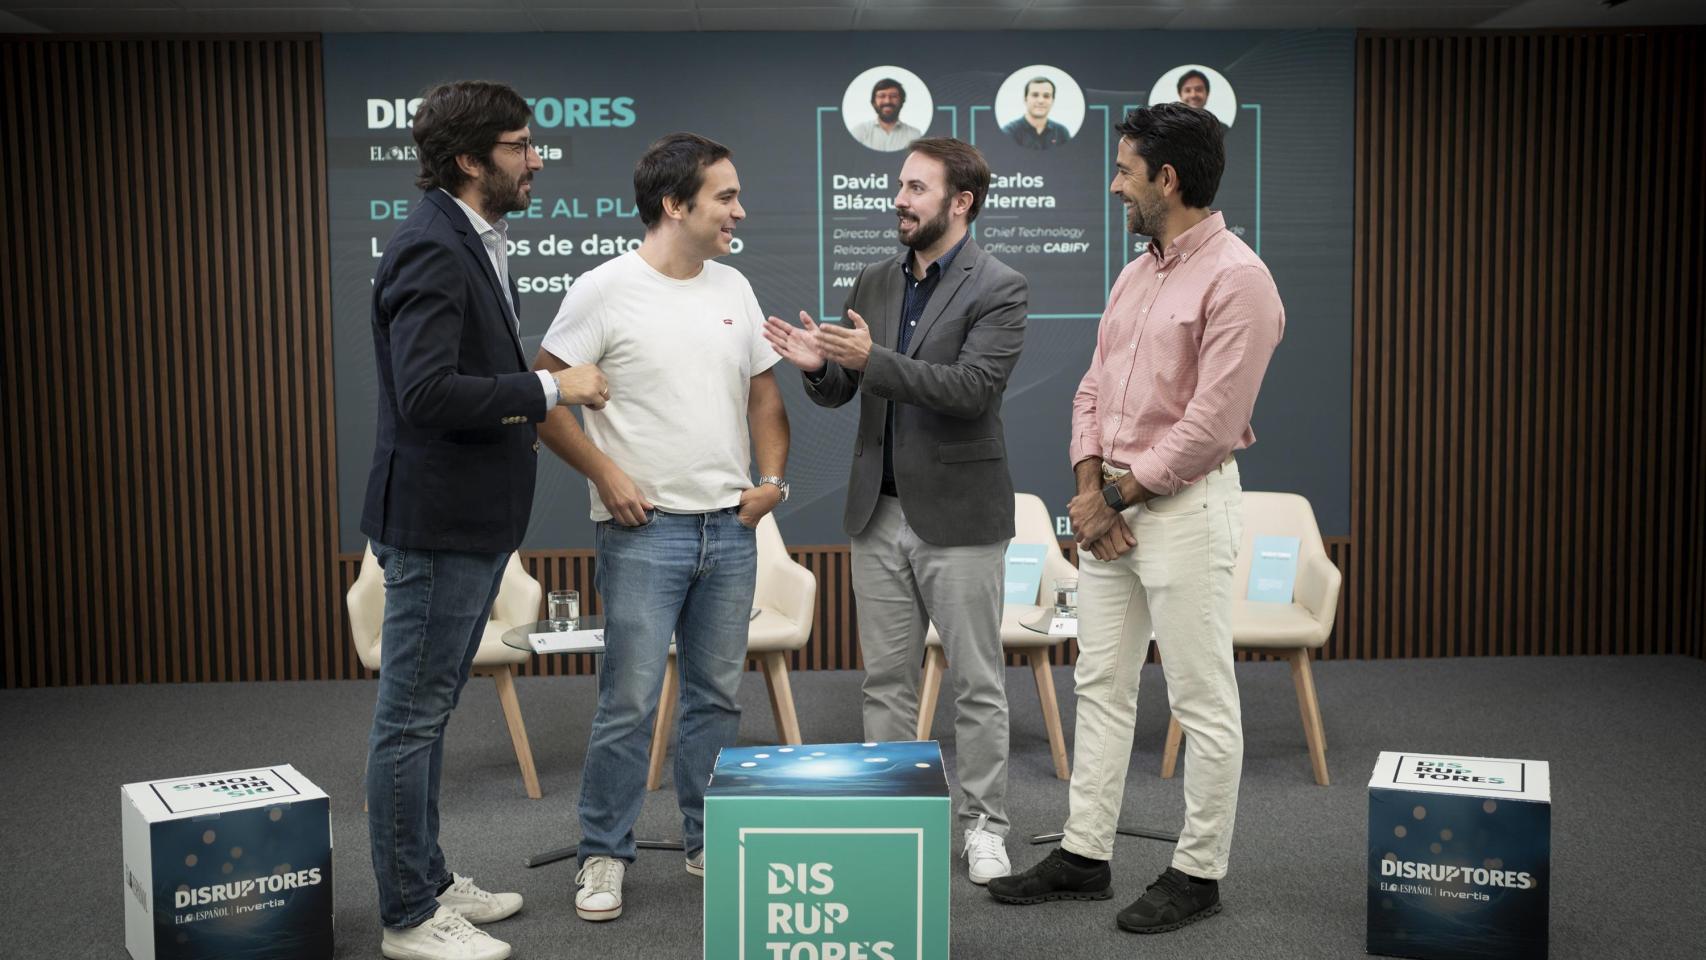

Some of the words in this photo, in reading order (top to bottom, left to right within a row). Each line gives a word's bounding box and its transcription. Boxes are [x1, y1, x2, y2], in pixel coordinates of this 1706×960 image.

[370, 146, 385, 161] EL
[833, 173, 888, 189] David
[988, 172, 1044, 188] Carlos
[833, 194, 897, 212] Blázqu
[984, 193, 1056, 208] Herrera
[370, 199, 409, 220] DE
[551, 198, 588, 218] AL
[833, 228, 880, 239] Director
[983, 226, 1016, 238] Chief
[1018, 226, 1085, 239] Technology
[537, 233, 574, 256] de
[580, 233, 643, 256] dato
[833, 244, 898, 255] Relaciones
[983, 243, 1023, 254] Officer
[1025, 242, 1041, 253] de
[1043, 242, 1090, 253] CABIFY
[833, 276, 857, 287] AW
[1413, 772, 1505, 784] TORES
[768, 862, 835, 895] DIS
[1381, 859, 1531, 889] DISRUPTORES
[175, 867, 322, 908] DISRUPTORES
[1400, 884, 1433, 896] ESPAÑOL
[1439, 888, 1490, 901] invertia
[196, 906, 229, 921] ESPAÑOL
[236, 898, 285, 914] invertia
[768, 902, 849, 934] RUP
[766, 941, 895, 960] TORES
